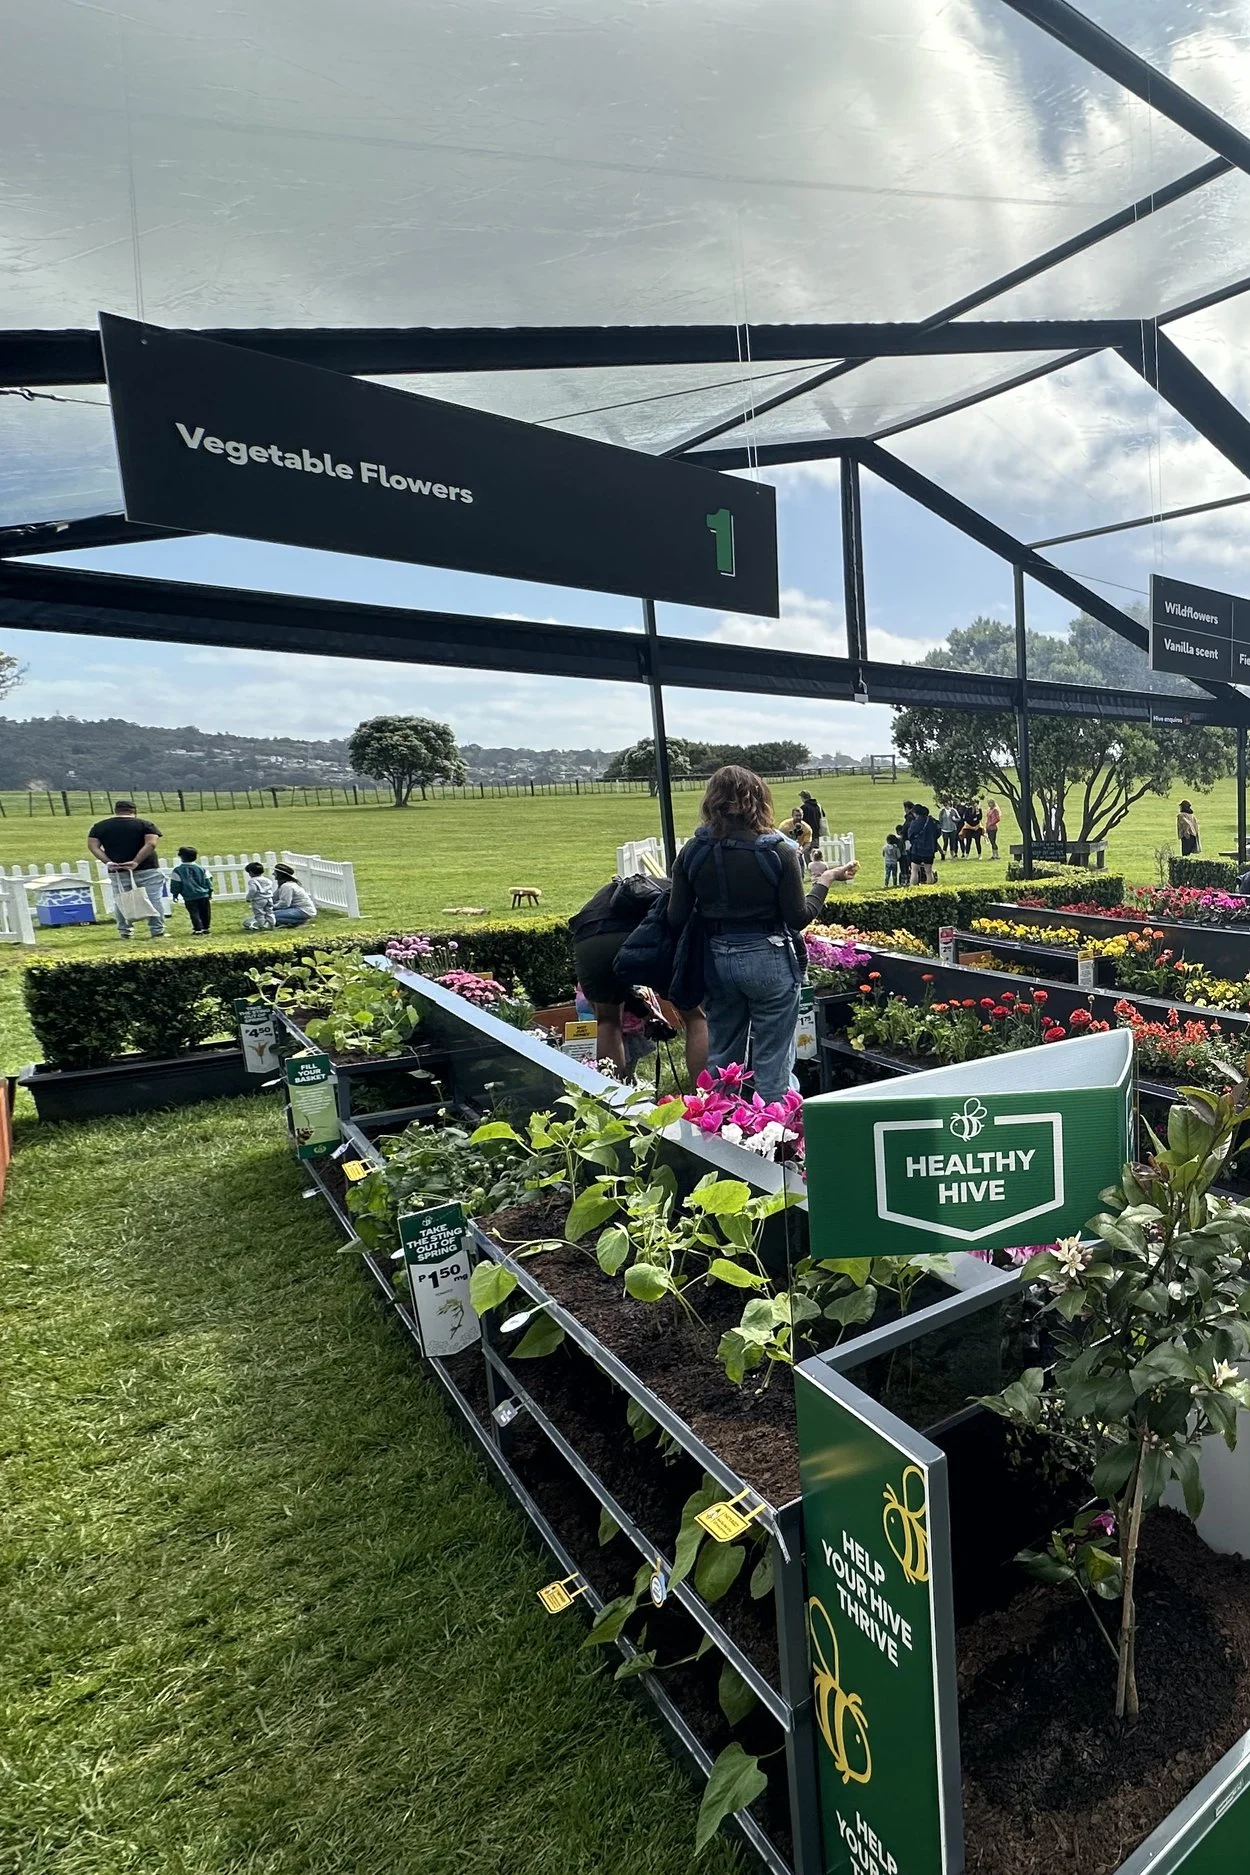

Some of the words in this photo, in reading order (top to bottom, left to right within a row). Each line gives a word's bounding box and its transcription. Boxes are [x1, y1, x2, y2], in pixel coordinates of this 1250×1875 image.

[175, 422, 354, 480] Vegetable
[360, 462, 474, 503] Flowers
[706, 508, 735, 576] 1
[1165, 601, 1218, 624] Wildflowers
[1164, 638, 1194, 655] Vanilla
[1195, 645, 1218, 659] scent
[294, 1073, 327, 1083] BASKET
[906, 1149, 1036, 1178] HEALTHY
[939, 1180, 1005, 1204] HIVE
[406, 1237, 429, 1248] THE
[430, 1228, 462, 1240] STING
[420, 1224, 447, 1237] TAKE
[416, 1242, 439, 1254] OUT
[441, 1237, 456, 1246] OF
[418, 1245, 457, 1261] SPRING
[842, 1530, 886, 1586] HELP
[822, 1538, 868, 1605] YOUR
[870, 1587, 912, 1651] HIVE
[836, 1582, 898, 1668] THRIVE
[856, 1811, 898, 1875] HELP
